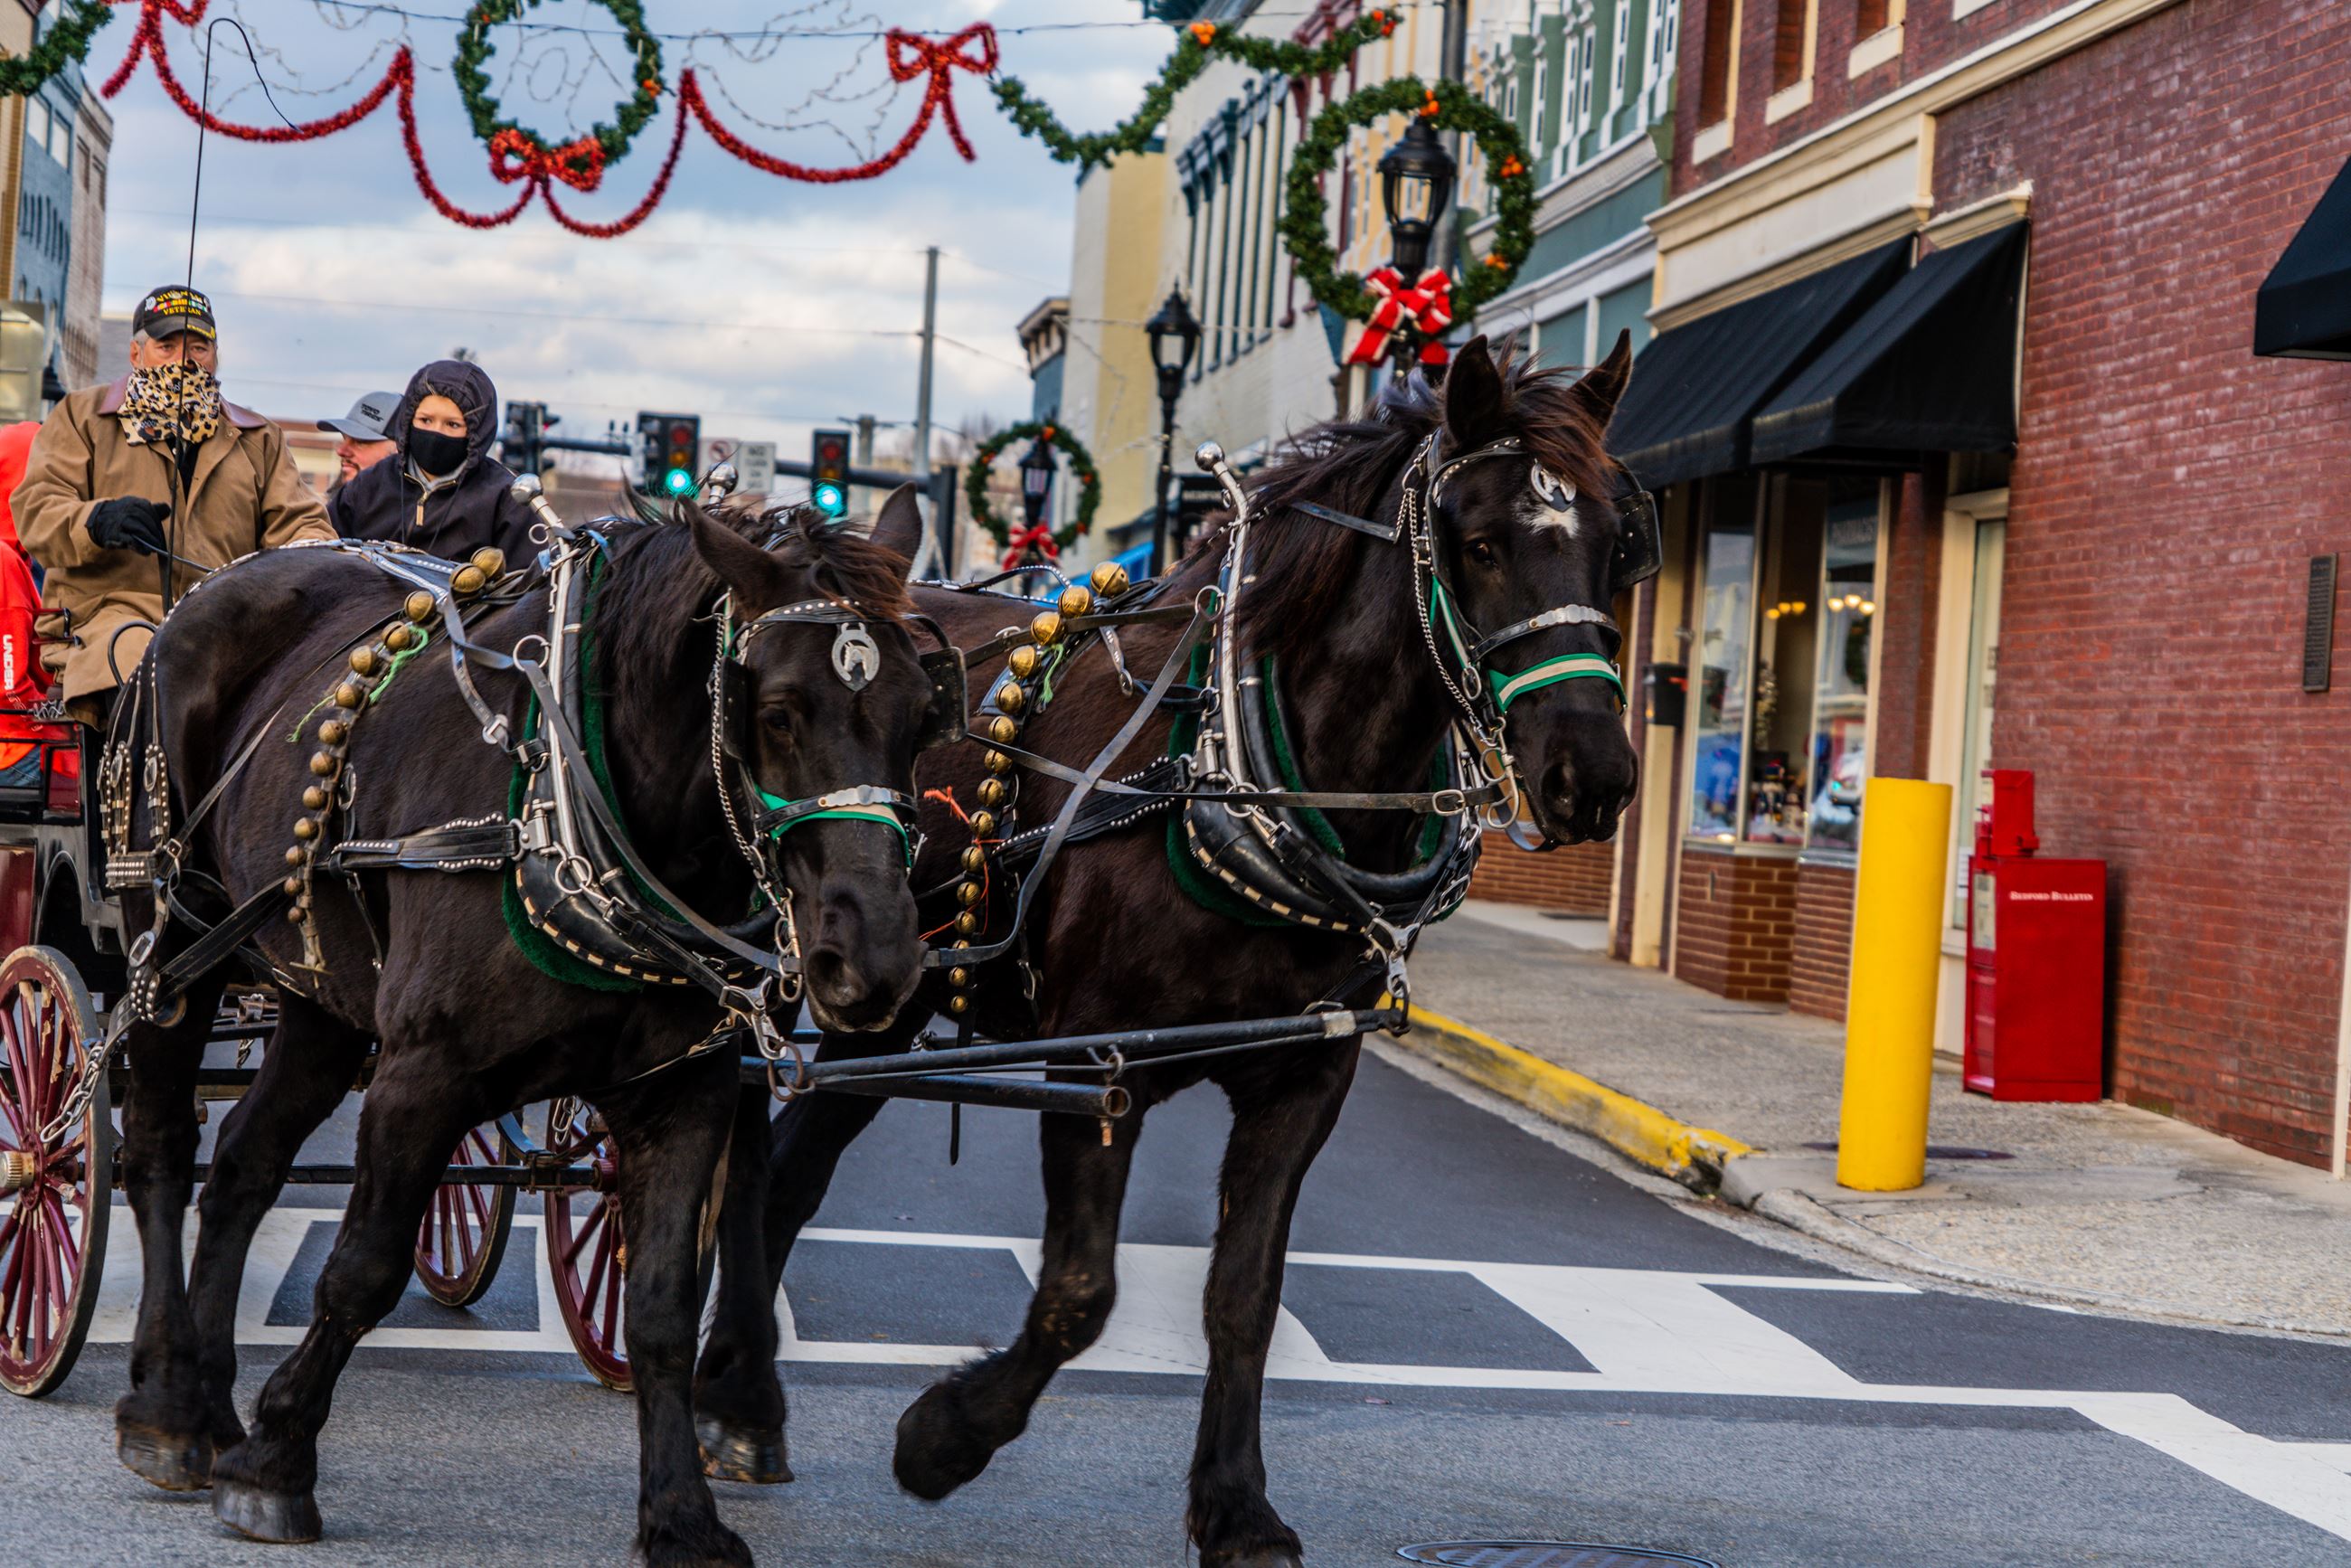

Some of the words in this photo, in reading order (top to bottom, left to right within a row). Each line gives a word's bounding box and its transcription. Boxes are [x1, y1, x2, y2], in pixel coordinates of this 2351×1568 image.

[163, 307, 202, 316] VETERAN
[3, 634, 14, 690] UNDER
[2009, 891, 2050, 902] BEDFORD
[2051, 891, 2093, 902] BULLETIN
